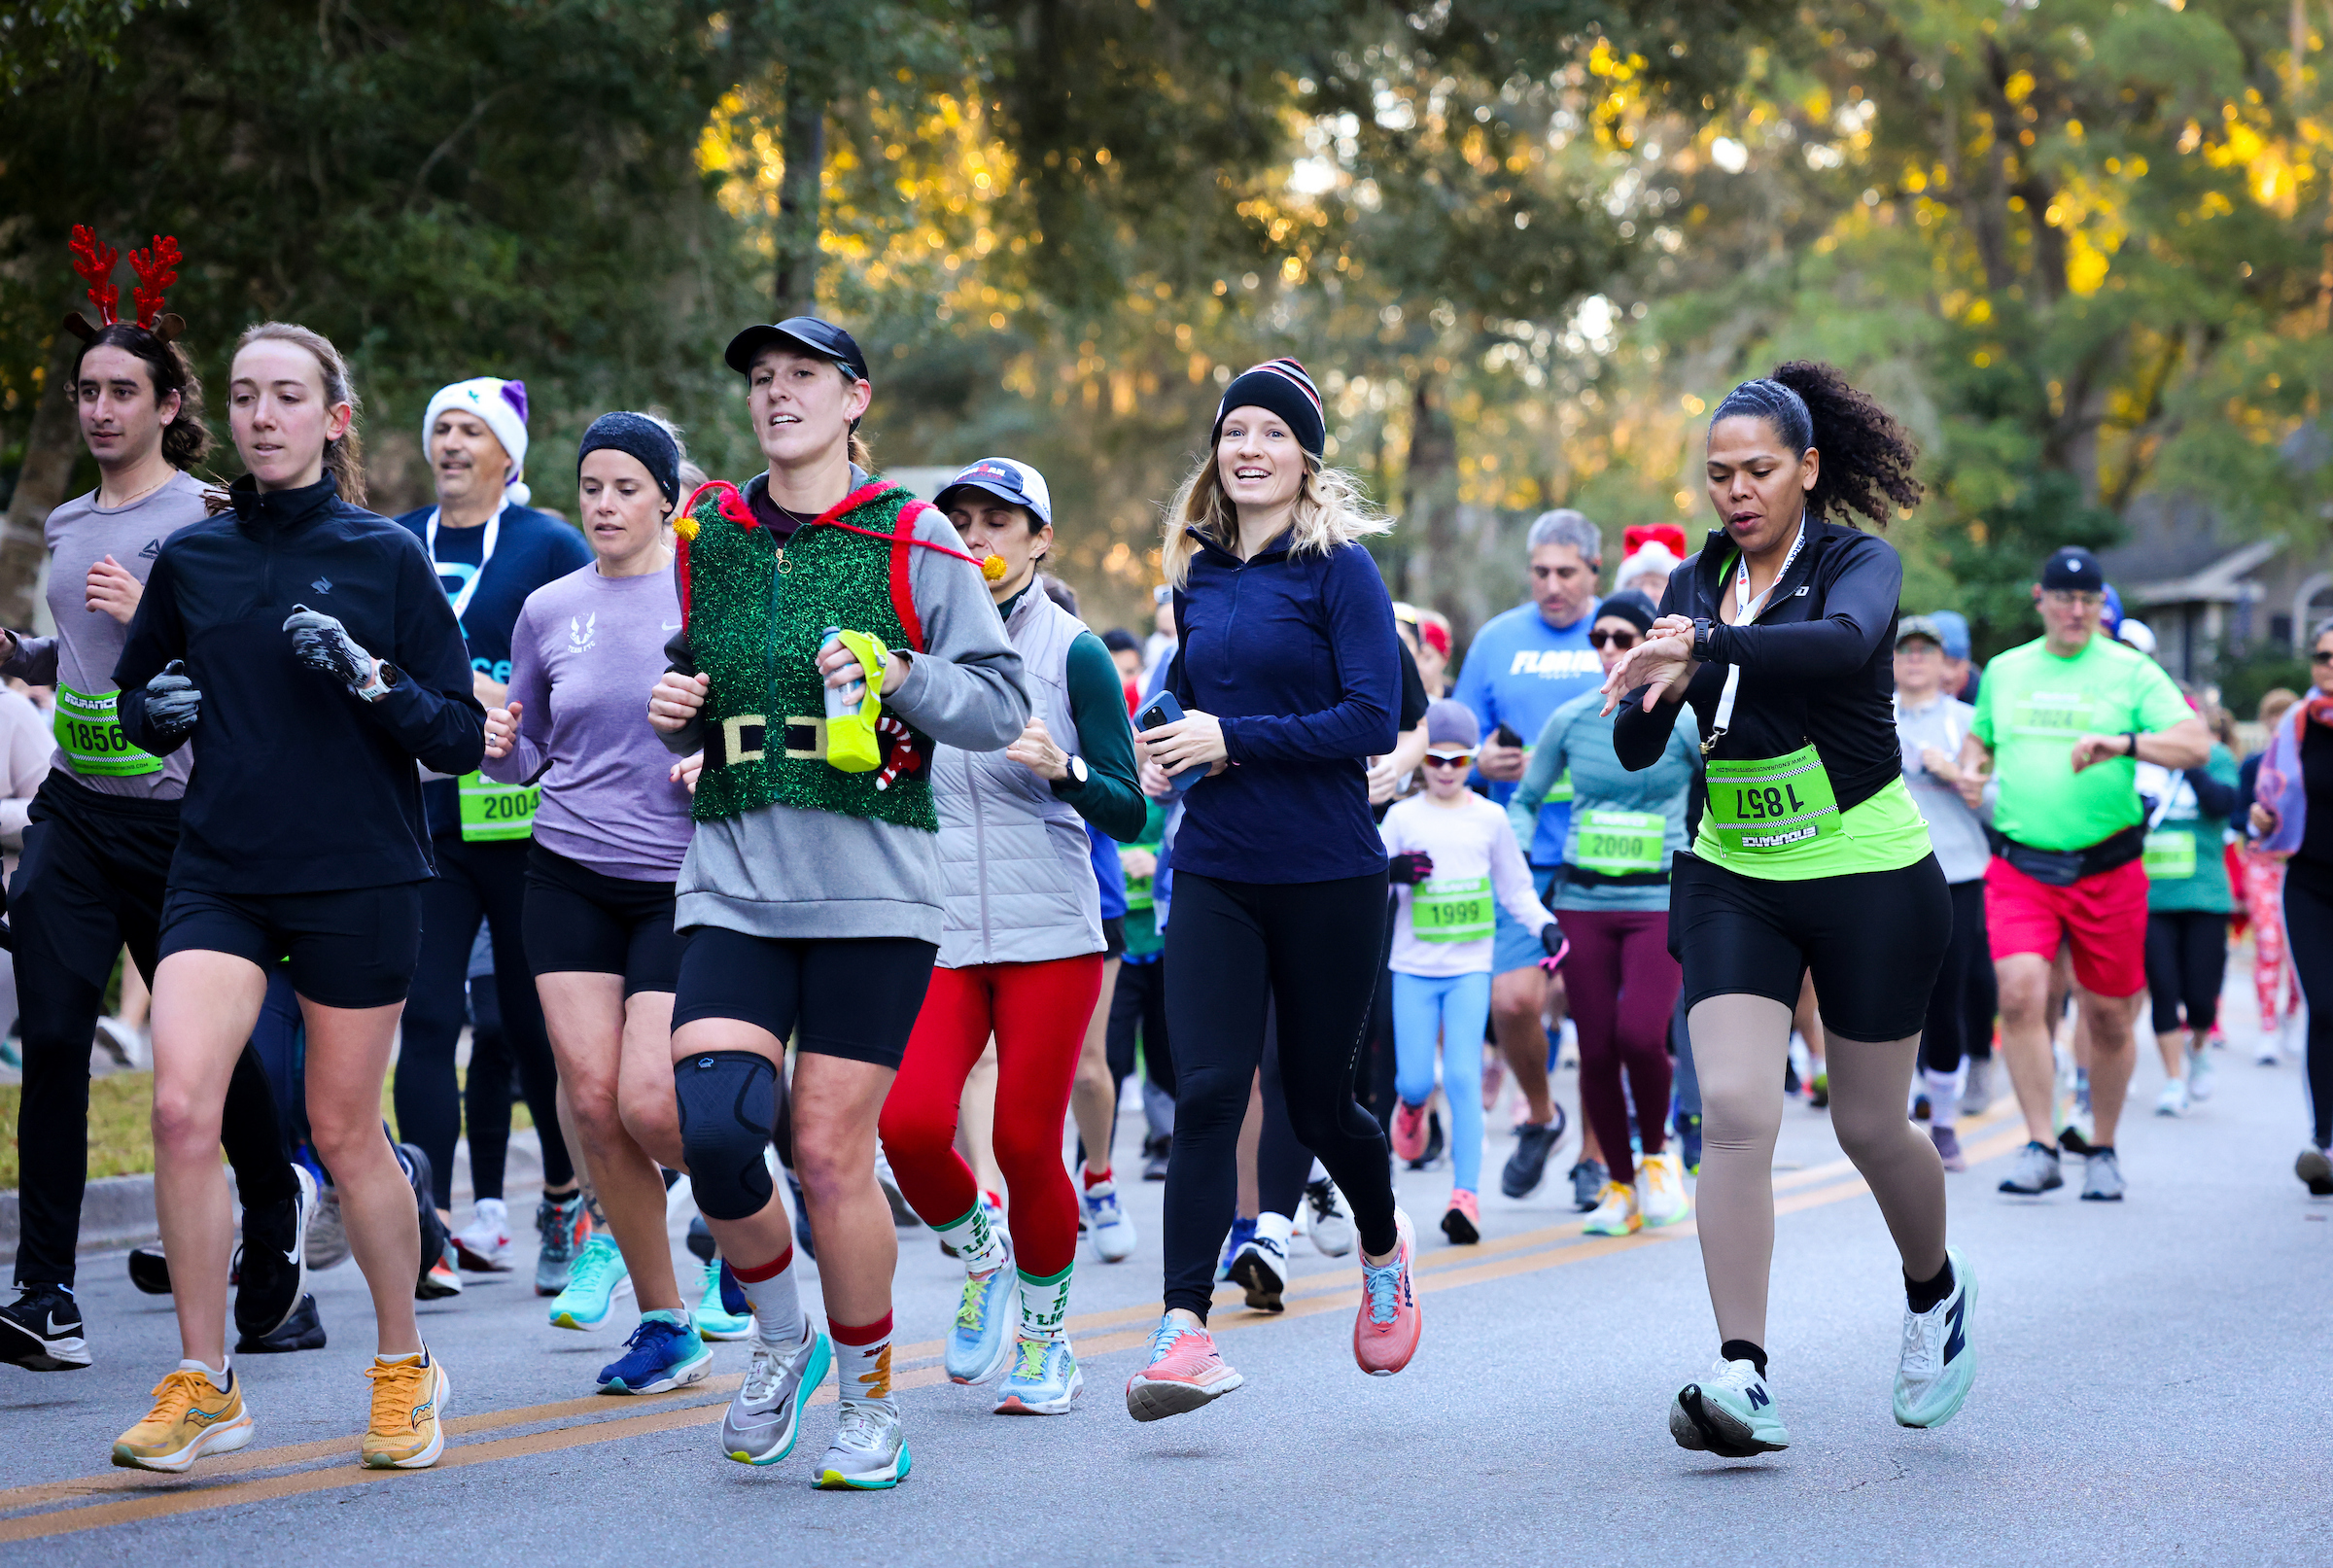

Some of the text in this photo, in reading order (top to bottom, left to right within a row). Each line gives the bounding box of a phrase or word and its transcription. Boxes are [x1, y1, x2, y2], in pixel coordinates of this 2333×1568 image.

[1509, 649, 1604, 676] FLORID
[67, 720, 128, 752] 1856
[1736, 783, 1805, 819] 1857
[1592, 834, 1644, 857] 2000
[1741, 825, 1818, 848] ENDURANCE
[1431, 900, 1480, 924] 1999
